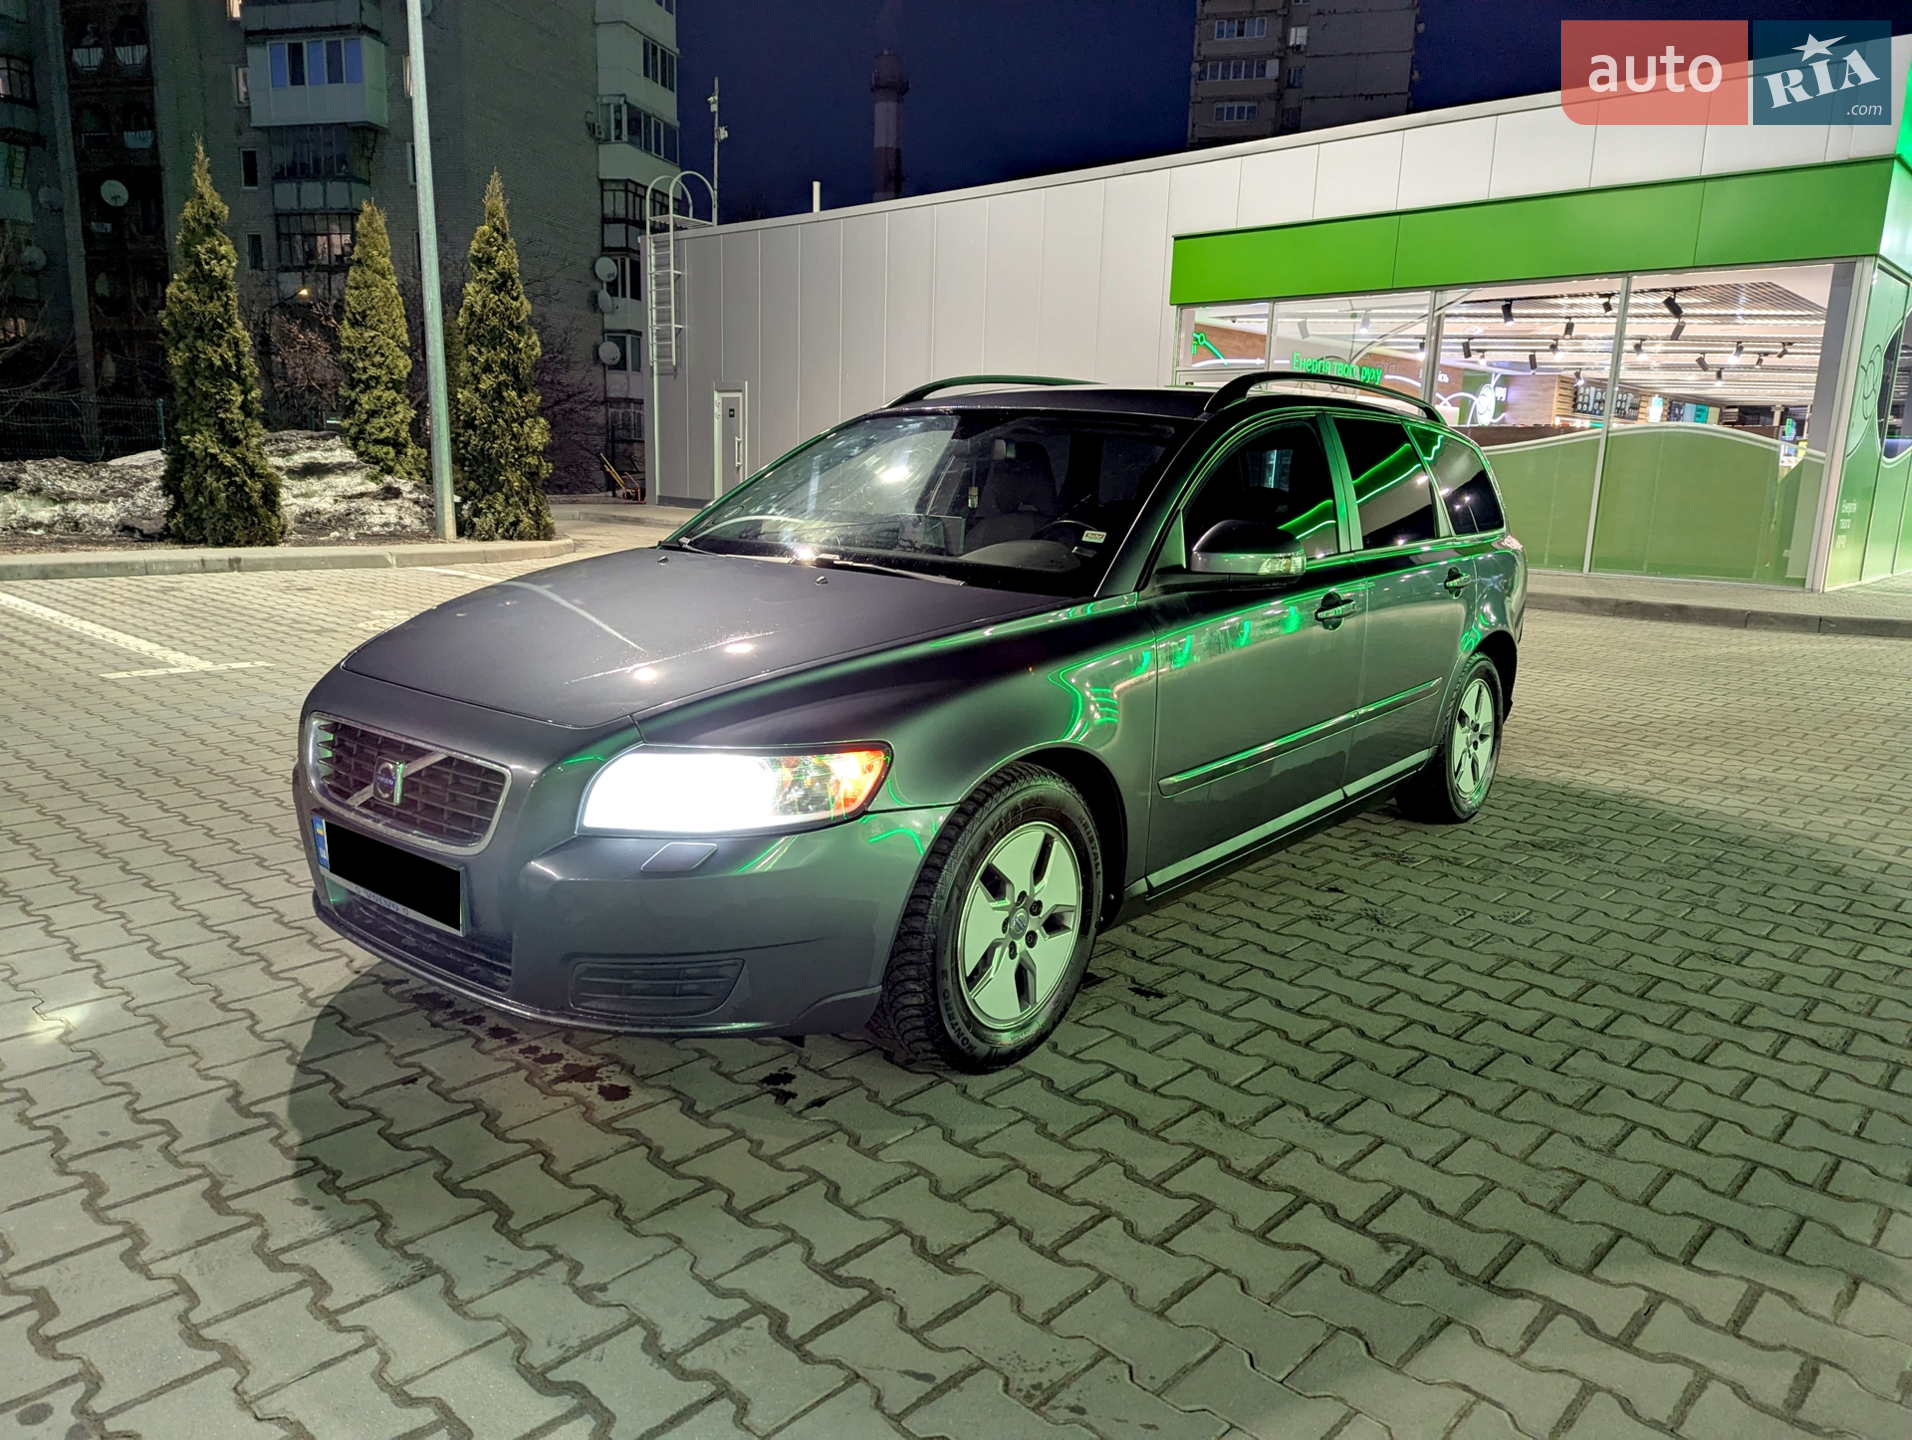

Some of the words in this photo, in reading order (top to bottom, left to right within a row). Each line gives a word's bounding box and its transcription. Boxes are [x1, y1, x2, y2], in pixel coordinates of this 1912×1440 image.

[1292, 352, 1331, 374] Енергія
[1360, 366, 1383, 386] руху
[364, 890, 400, 911] VOLVO
